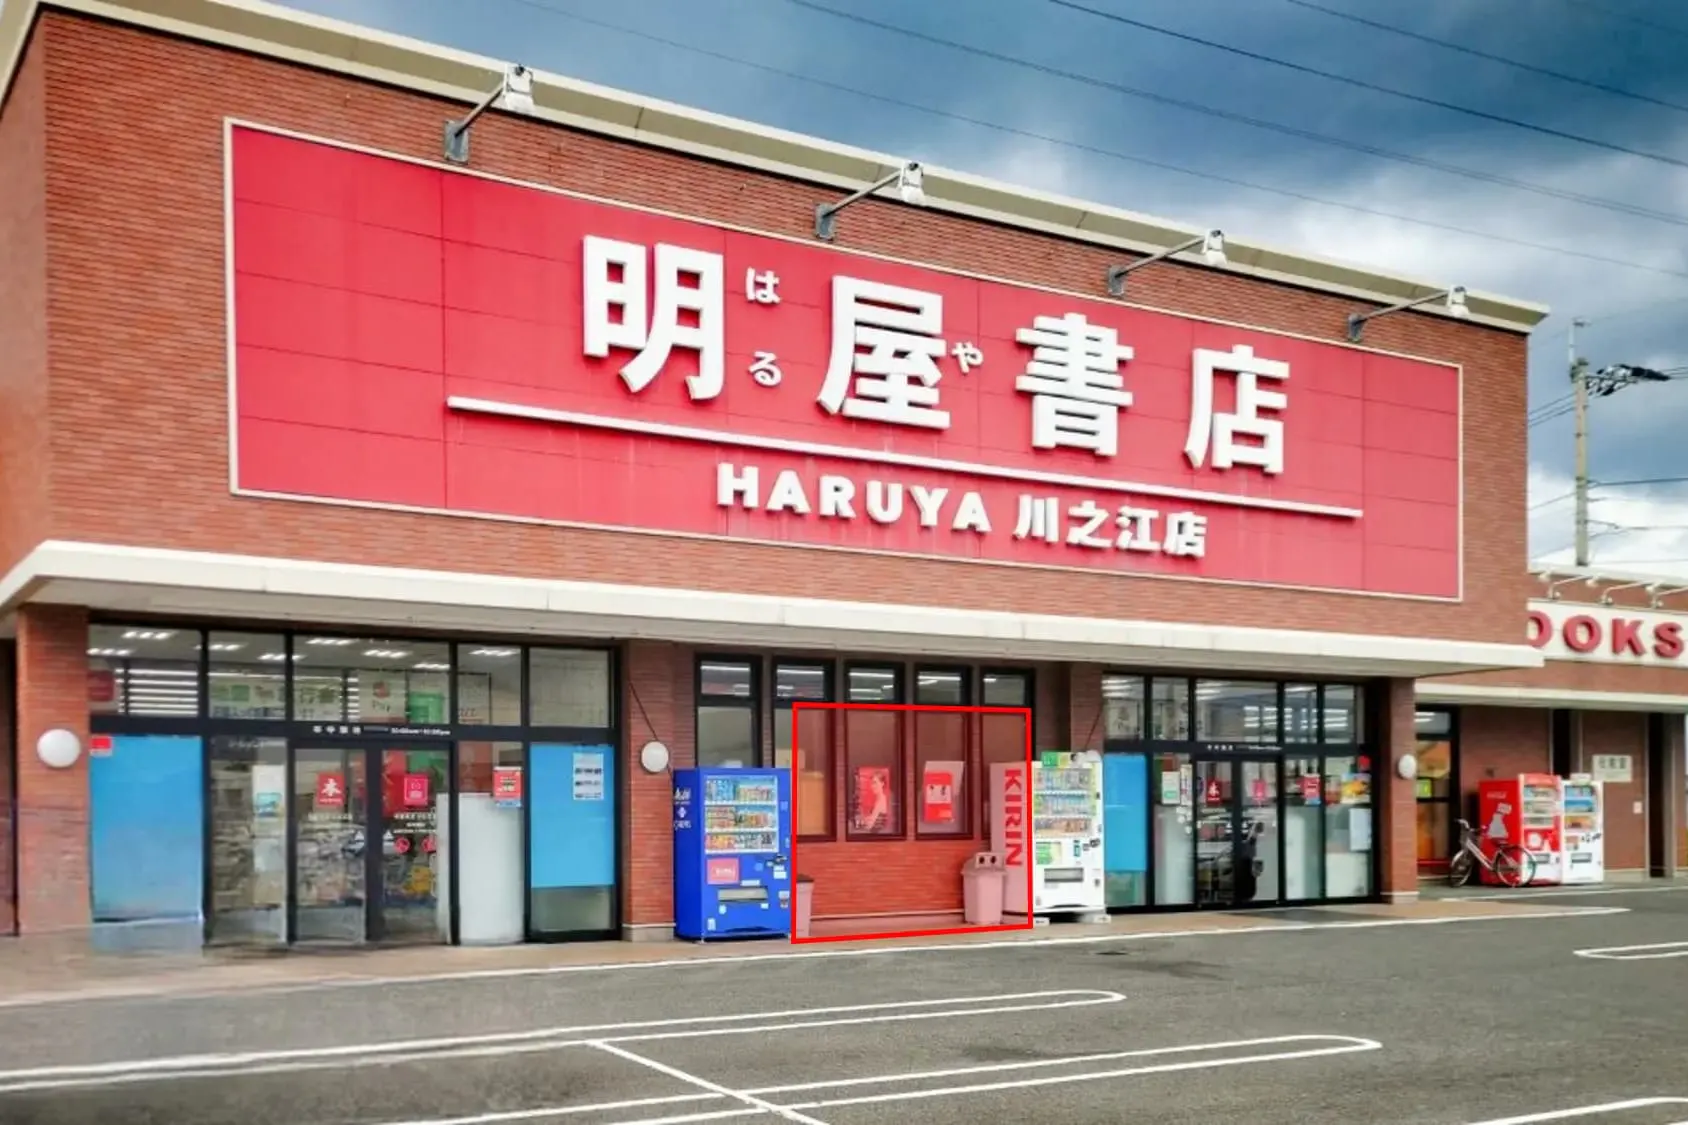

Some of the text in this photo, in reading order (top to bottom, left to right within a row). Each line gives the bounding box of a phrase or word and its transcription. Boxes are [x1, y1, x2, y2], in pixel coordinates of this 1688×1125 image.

[583, 235, 1290, 474] 明屋書店
[952, 341, 984, 374] や
[716, 462, 1208, 558] HARUYA 川之江店
[1004, 768, 1023, 867] KIRIN
